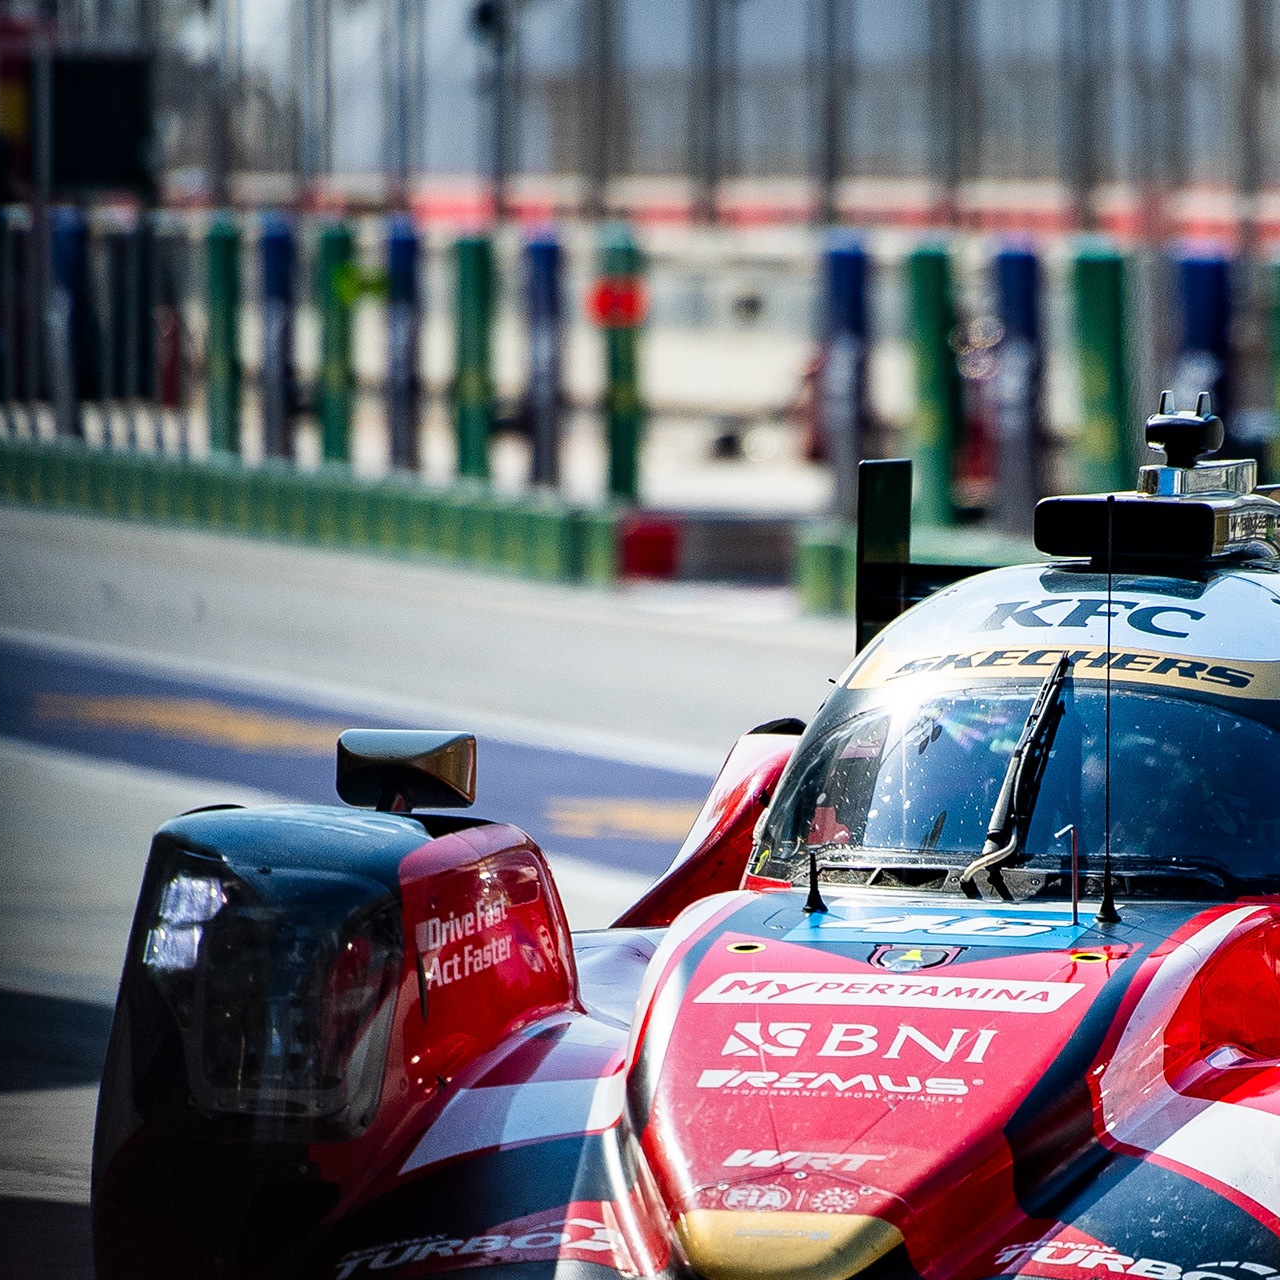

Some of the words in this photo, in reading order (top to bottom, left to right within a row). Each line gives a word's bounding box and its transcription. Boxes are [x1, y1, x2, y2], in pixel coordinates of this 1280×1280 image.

[970, 598, 1207, 639] KFC
[884, 649, 1256, 689] SKECHERS
[428, 912, 475, 950] Drive
[476, 896, 508, 932] Fast
[818, 914, 1073, 938] 46
[427, 953, 462, 990] Act
[464, 935, 513, 977] Faster
[818, 1023, 1000, 1064] BNI
[722, 1088, 828, 1098] PERFORMANCE
[834, 1090, 881, 1100] SPORT
[722, 1149, 886, 1172] WRT
[725, 1190, 783, 1208] FIA
